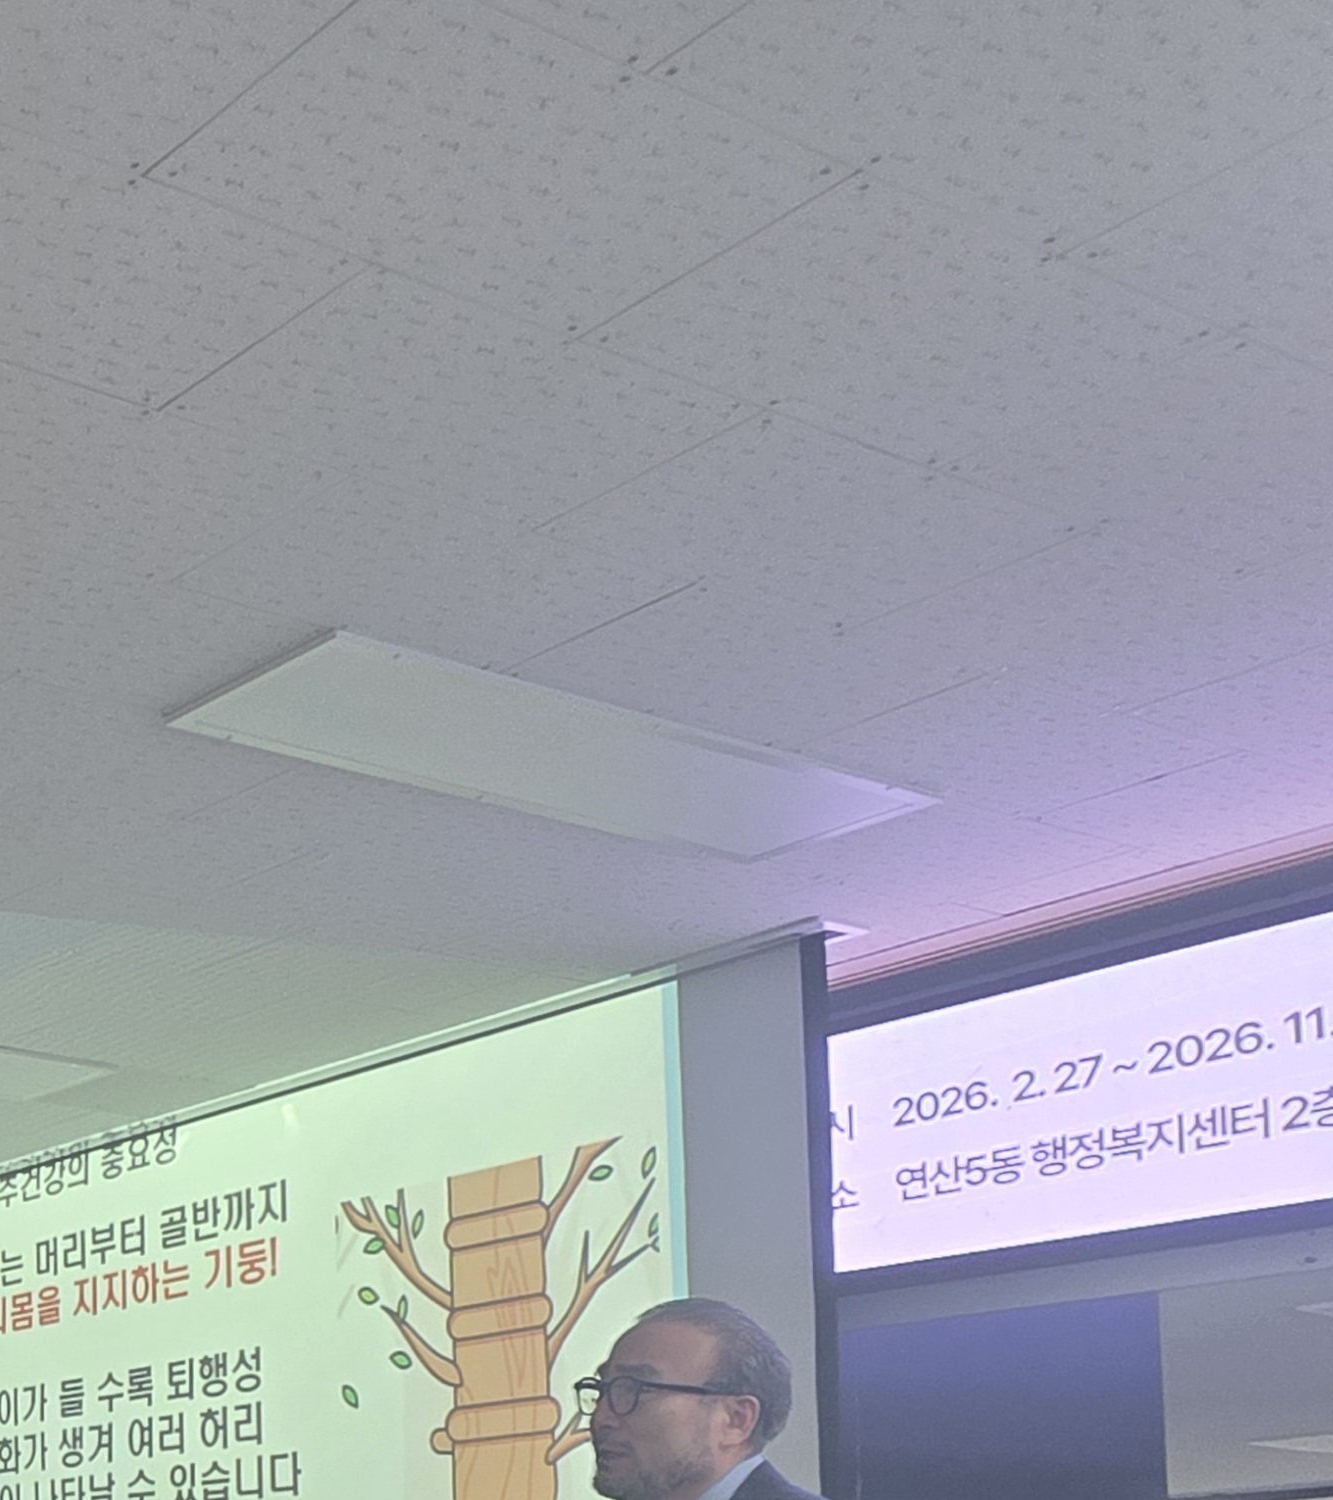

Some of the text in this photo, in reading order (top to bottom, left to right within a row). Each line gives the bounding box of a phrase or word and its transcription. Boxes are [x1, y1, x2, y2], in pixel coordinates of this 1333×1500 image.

[893, 1081, 998, 1127] 2026.
[1012, 1071, 1045, 1102] 2.
[1054, 1055, 1102, 1093] 27
[1148, 1020, 1274, 1074] 2026.
[895, 1145, 1023, 1201] 연산5동
[1032, 1097, 1271, 1178] 행정복지센터
[35, 1214, 146, 1277] 머리부터
[160, 1178, 288, 1249] 골반까지
[73, 1257, 189, 1317] 지지하는
[204, 1237, 279, 1289] 기둥!
[59, 1377, 85, 1418] 들
[97, 1365, 154, 1412] 수록
[167, 1346, 262, 1400] 퇴행성
[59, 1422, 113, 1468] 생겨
[128, 1412, 184, 1458] 여러
[200, 1401, 263, 1450] 허리
